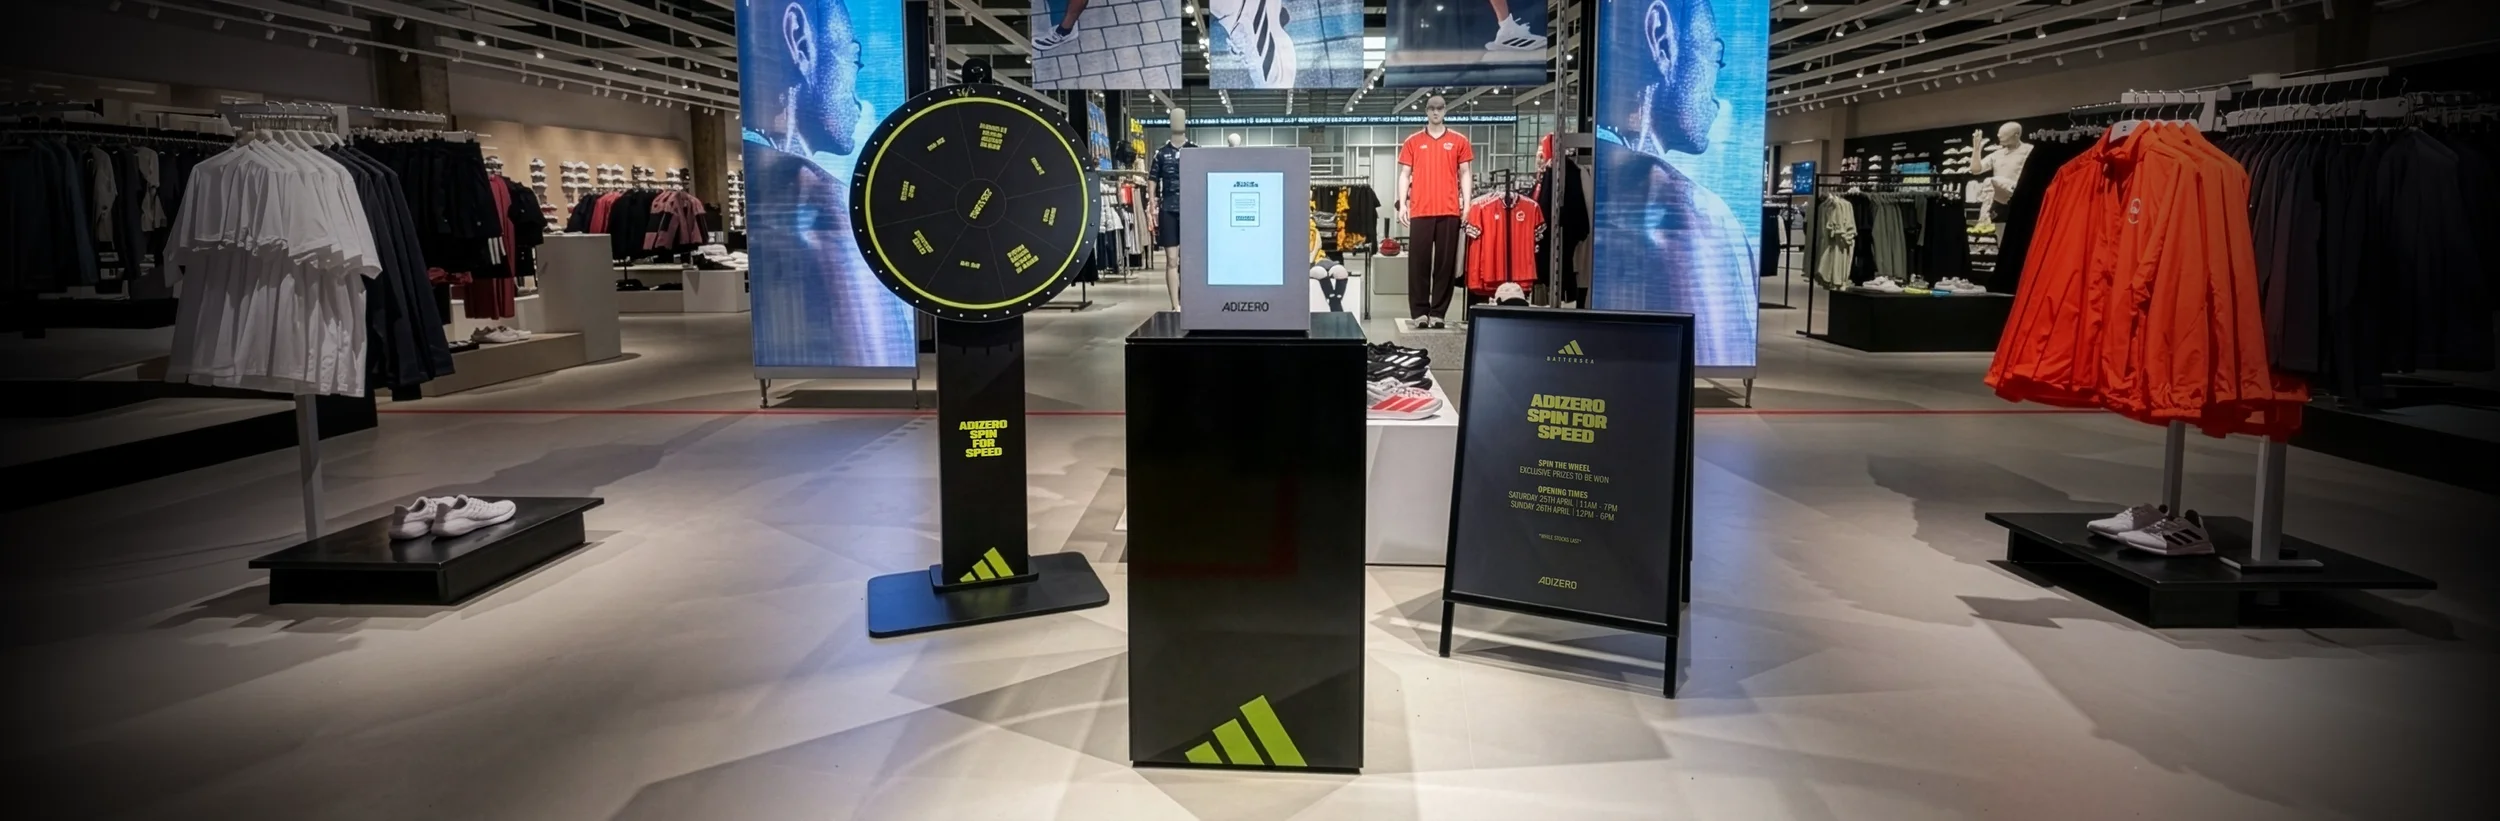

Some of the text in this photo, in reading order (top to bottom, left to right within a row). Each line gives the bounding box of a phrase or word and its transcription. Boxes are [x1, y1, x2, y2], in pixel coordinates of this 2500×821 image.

[1222, 302, 1269, 312] ADIZERO
[1547, 356, 1594, 364] BATTERSEA
[1531, 394, 1605, 413] ADIZERO
[959, 420, 1008, 430] ADIZERO
[1527, 408, 1607, 429] SPIN FOR
[970, 429, 997, 439] SPIN
[1538, 425, 1594, 443] SPEED
[972, 439, 995, 448] FOR
[966, 447, 1002, 458] SPEED
[1539, 459, 1553, 467] SPIN
[1568, 463, 1590, 472] WHEEL
[1520, 466, 1551, 477] EXCLUSIVE
[1552, 470, 1574, 479] PRIZES
[1594, 475, 1609, 483] WON
[1538, 486, 1588, 498] OPENING TIMES
[1509, 491, 1538, 501] SATURDAY
[1539, 495, 1555, 503] 25TH
[1556, 497, 1573, 506] APRIL
[1580, 501, 1597, 509] 11AM
[1604, 503, 1618, 512] 7PM
[1511, 501, 1534, 510] SUNDAY
[1536, 504, 1552, 512] 26TH
[1553, 506, 1570, 515] APRIL
[1576, 510, 1594, 518] 12PM
[1600, 513, 1614, 521] 6PM
[1538, 576, 1577, 589] ADIZERO
